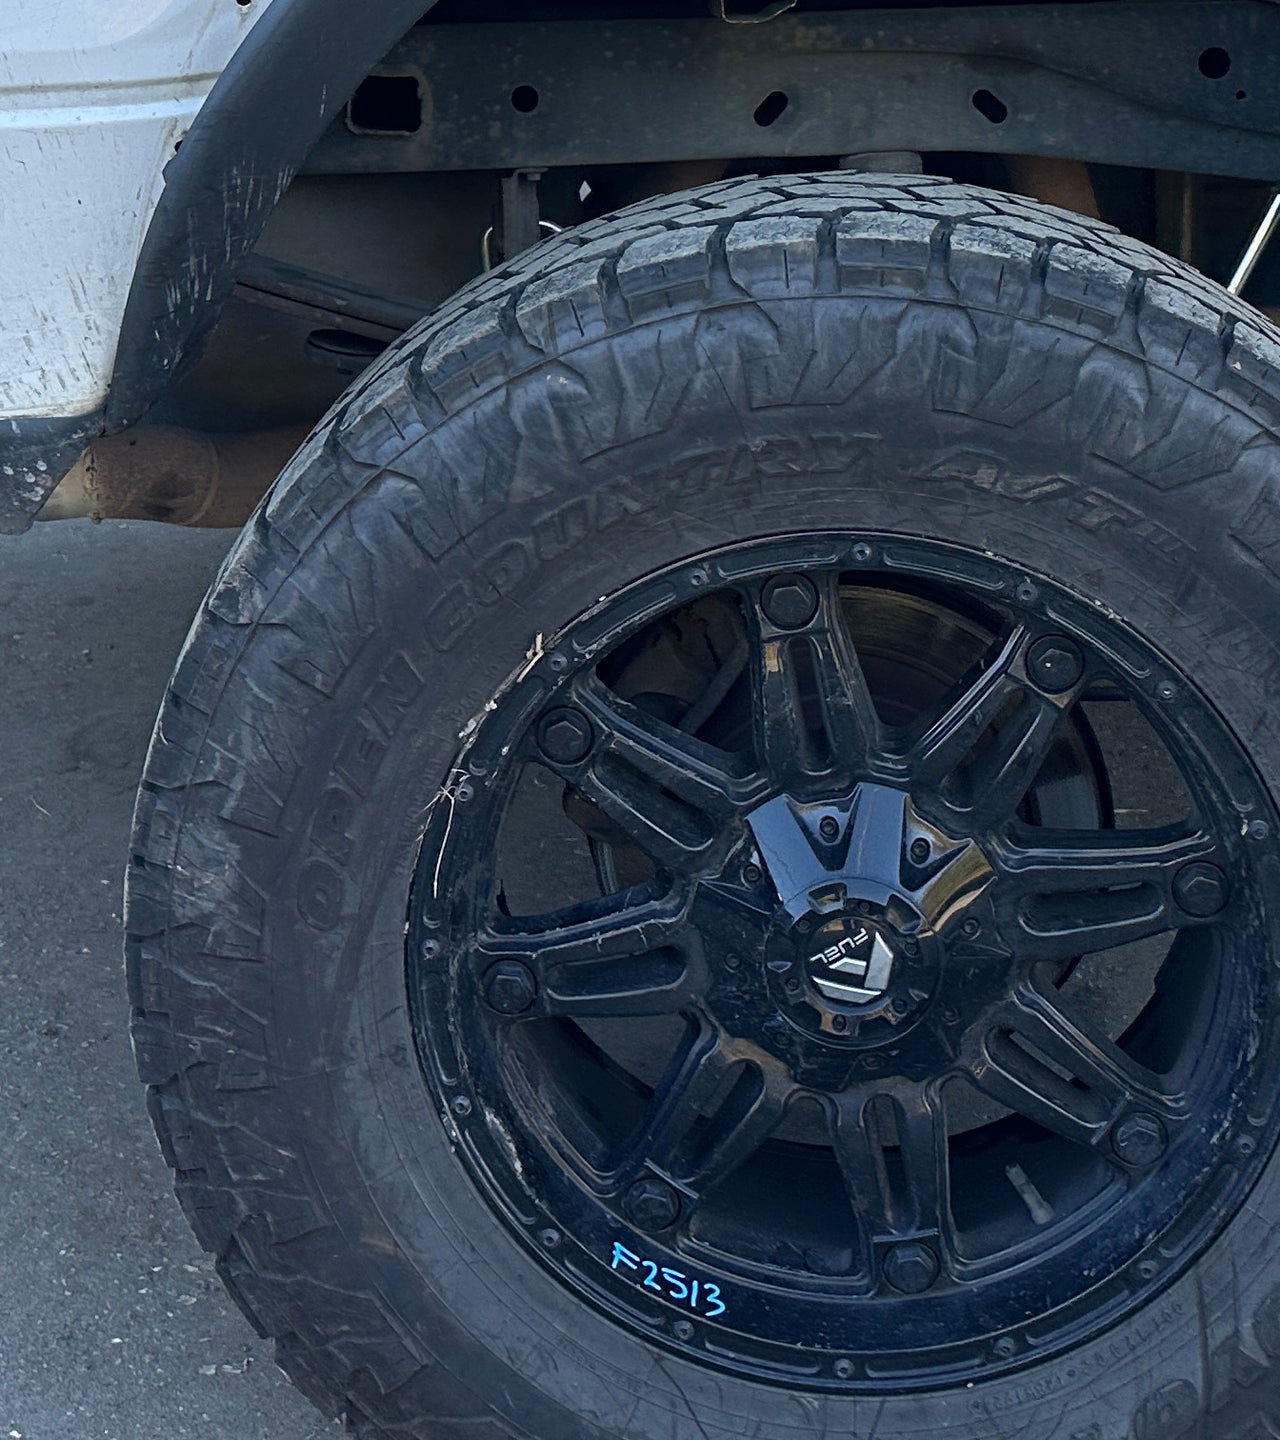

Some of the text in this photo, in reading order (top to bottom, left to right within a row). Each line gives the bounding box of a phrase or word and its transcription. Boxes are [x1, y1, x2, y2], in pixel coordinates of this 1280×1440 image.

[296, 648, 426, 932] OPEN
[423, 430, 884, 654] COUNTRY
[809, 927, 869, 964] FUEL
[612, 1241, 726, 1317] F2513
